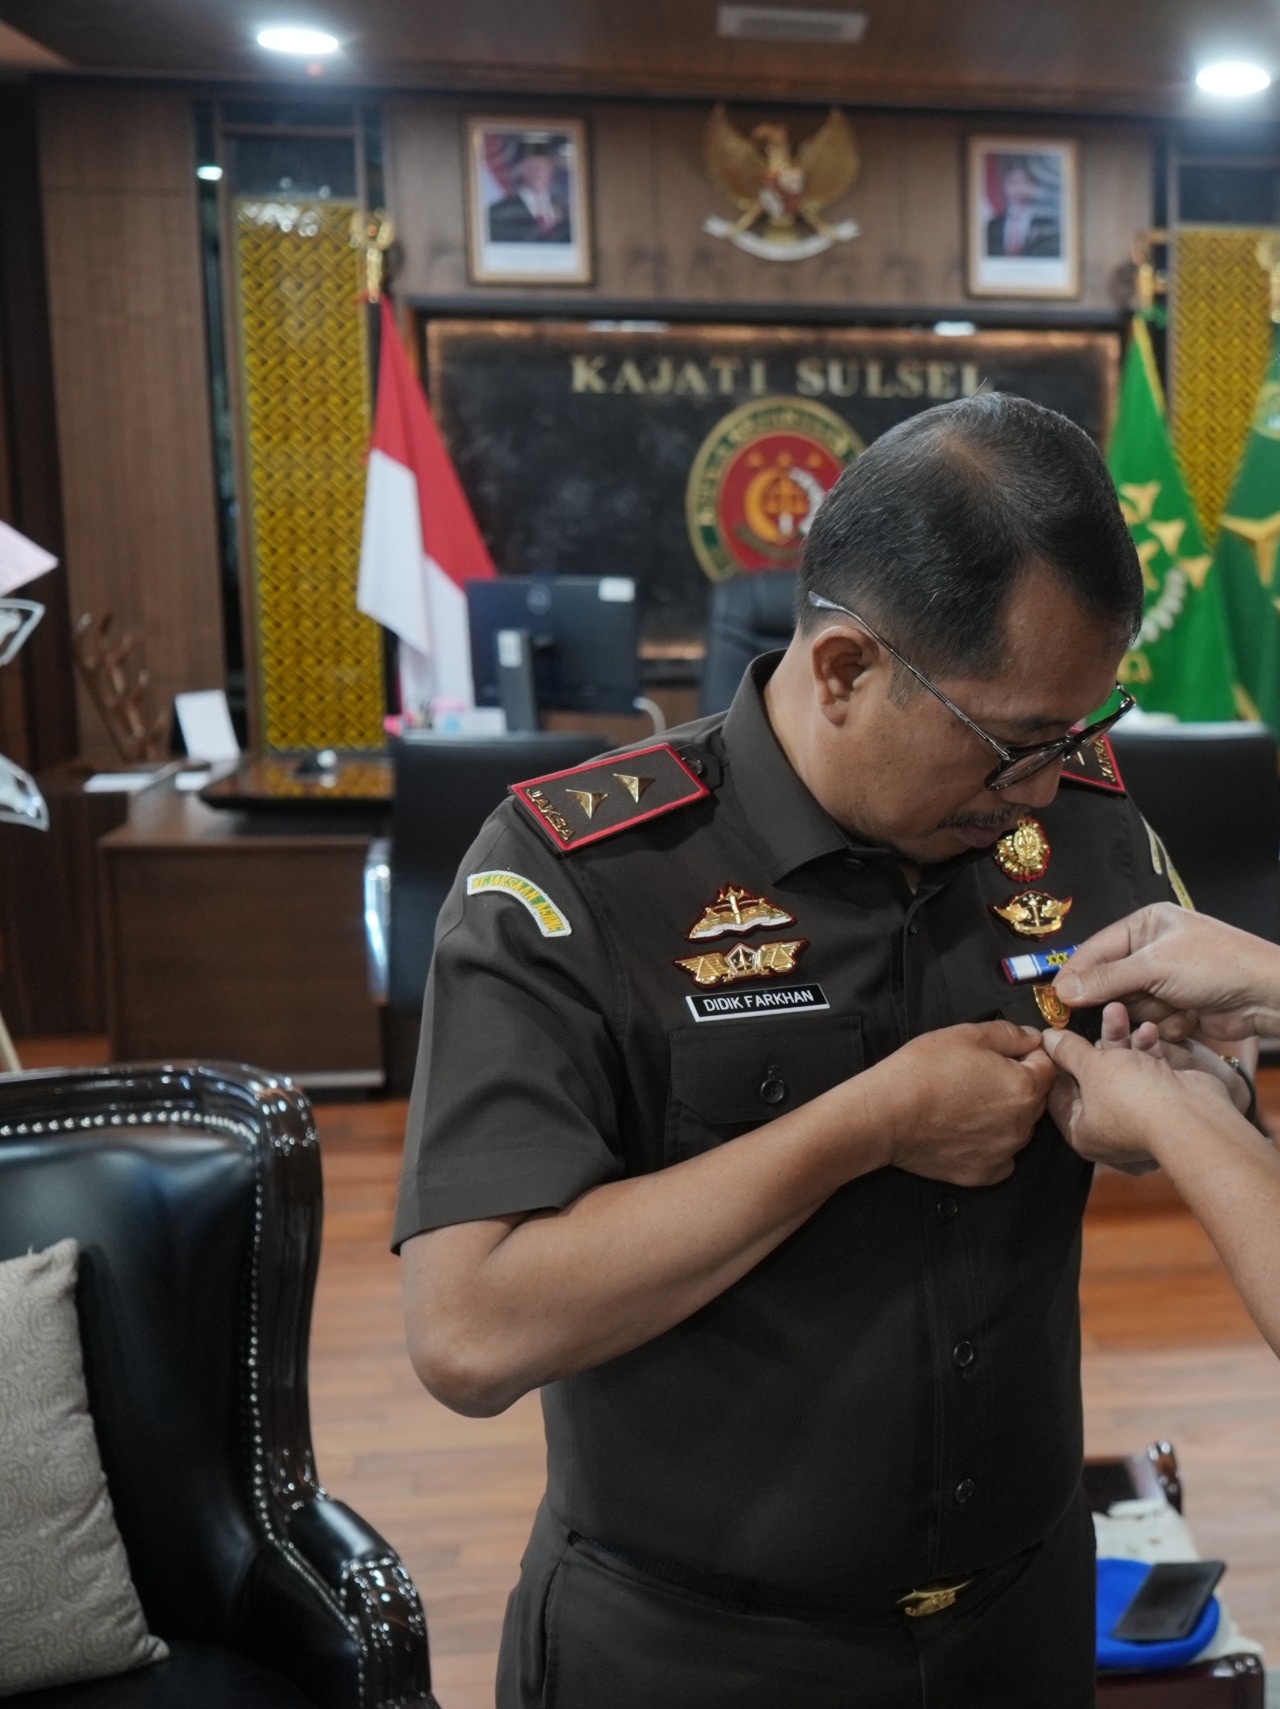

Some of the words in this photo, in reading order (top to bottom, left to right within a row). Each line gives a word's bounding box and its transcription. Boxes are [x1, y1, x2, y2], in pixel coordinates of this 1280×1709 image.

[571, 356, 767, 394] KAJATI
[796, 357, 994, 399] SULSEL
[527, 789, 577, 841] JAKSA
[702, 997, 743, 1012] DIDIK
[744, 989, 815, 1008] FARKHAN
